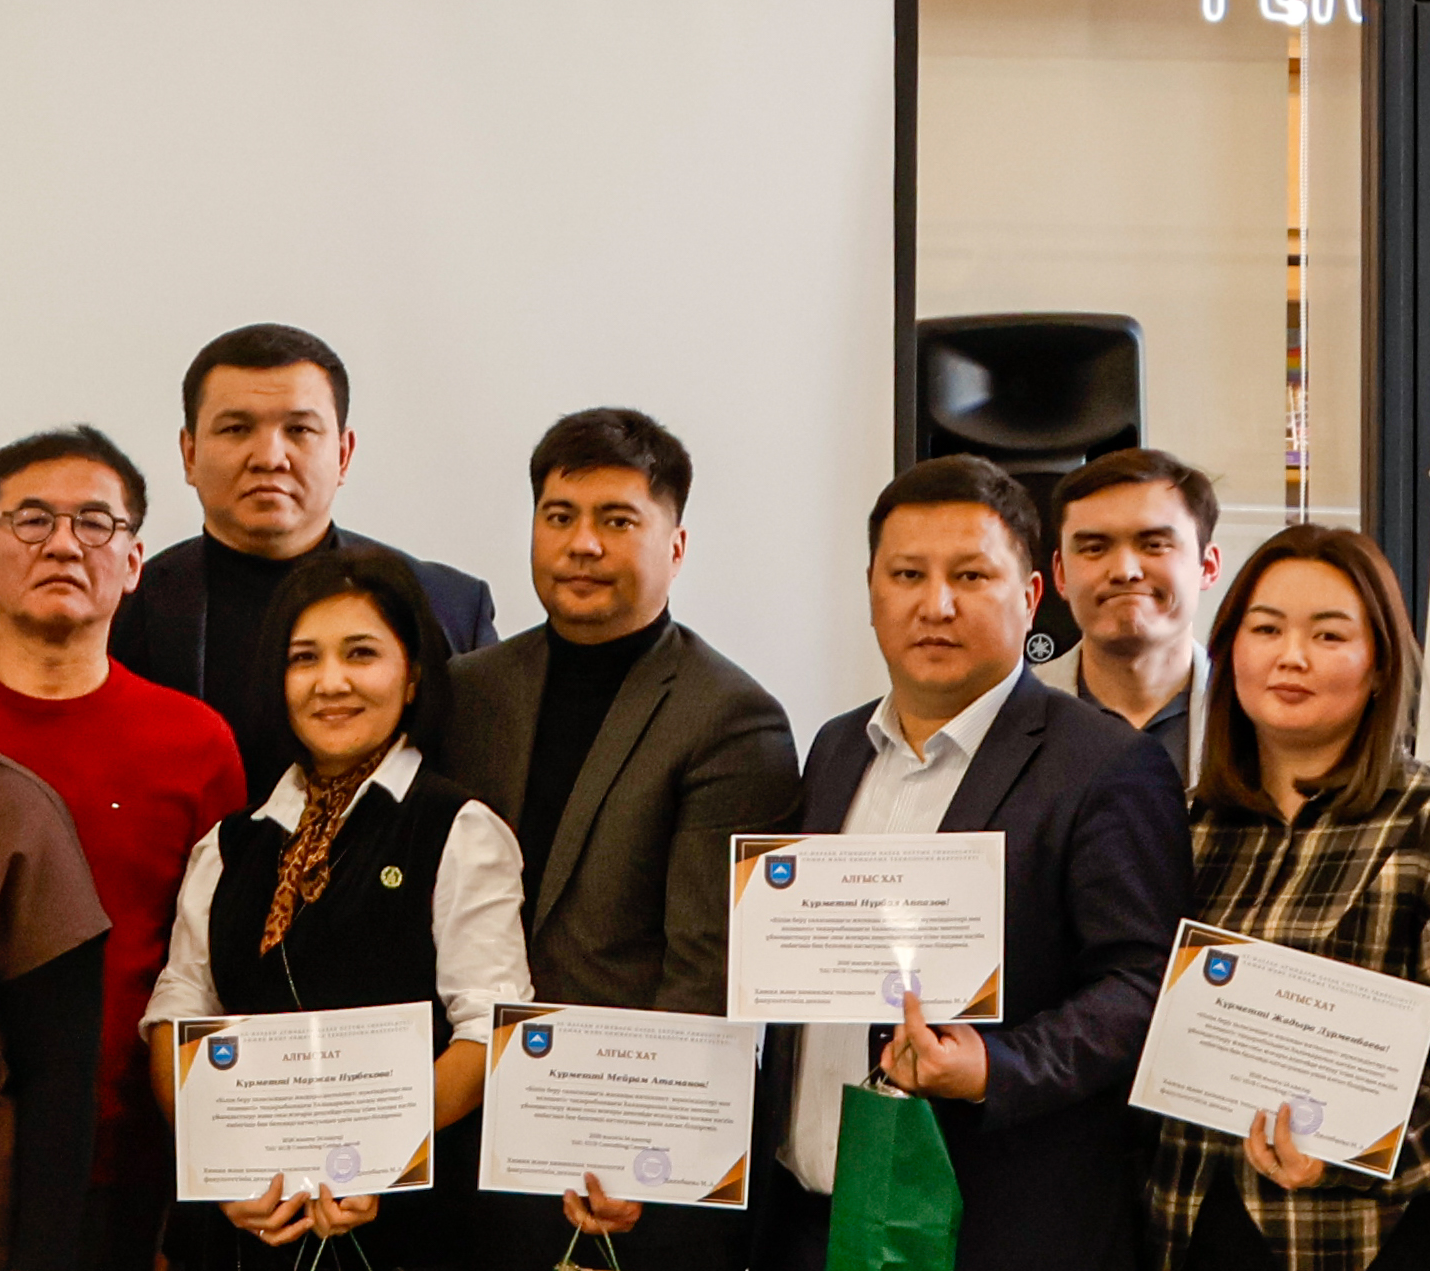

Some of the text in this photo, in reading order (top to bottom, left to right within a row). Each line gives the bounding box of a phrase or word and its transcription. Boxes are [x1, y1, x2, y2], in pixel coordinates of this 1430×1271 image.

[882, 874, 903, 882] ХАТ
[1313, 999, 1335, 1012] ХАТ
[320, 1050, 341, 1059] ХАТ
[635, 1050, 657, 1060] ХАТ
